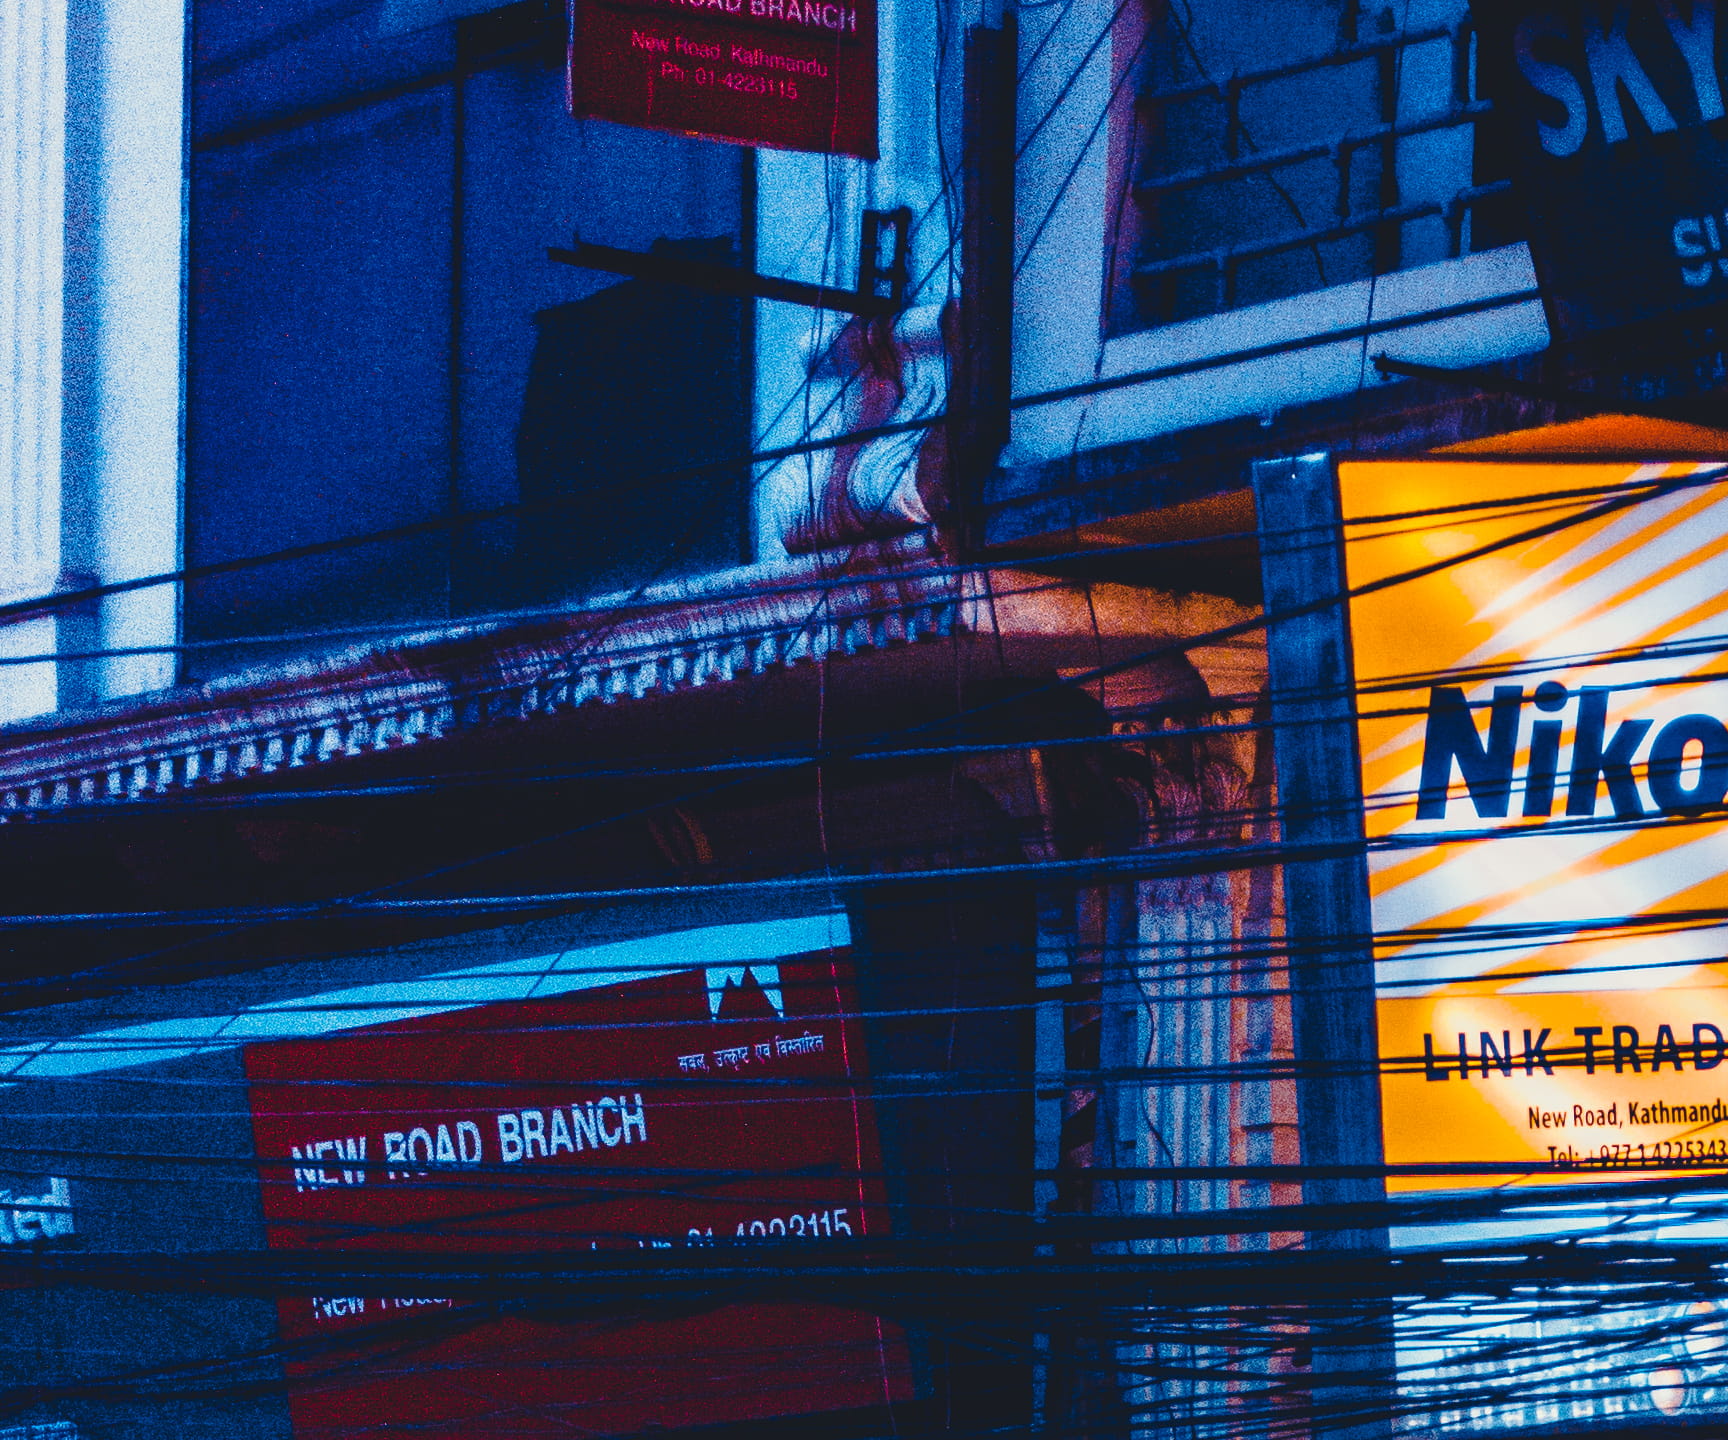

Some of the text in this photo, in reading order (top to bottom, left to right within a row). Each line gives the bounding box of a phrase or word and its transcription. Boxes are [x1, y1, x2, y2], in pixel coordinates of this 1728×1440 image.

[1423, 1028, 1554, 1082] LINK
[291, 1136, 368, 1192] NEW
[496, 1093, 648, 1164] BRANCH
[1528, 1106, 1568, 1129] New
